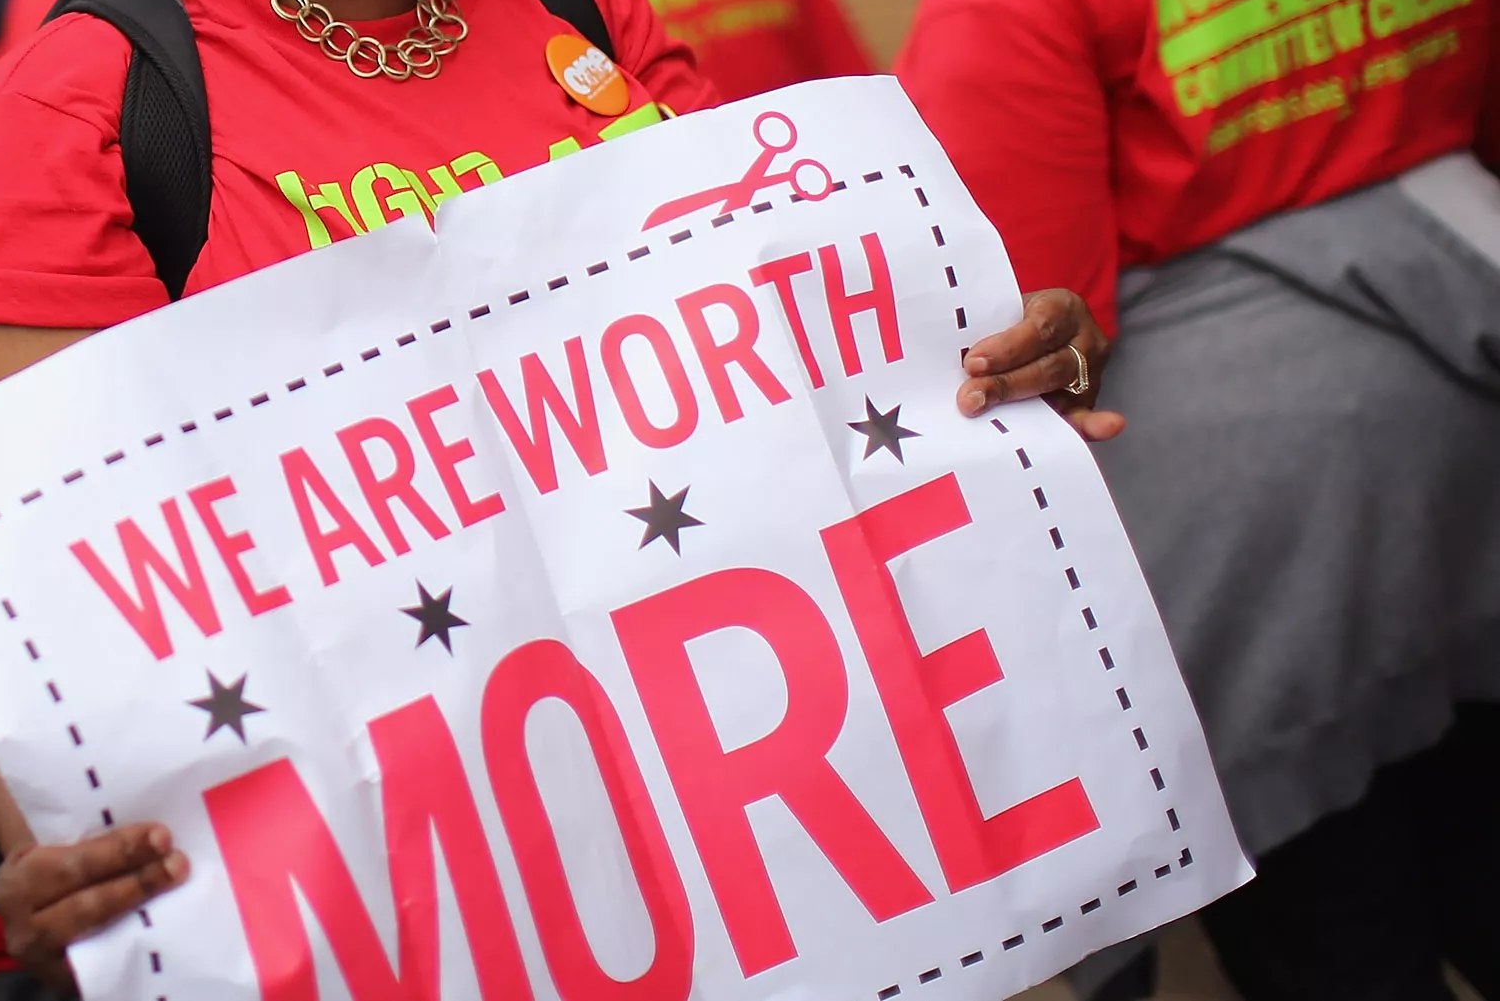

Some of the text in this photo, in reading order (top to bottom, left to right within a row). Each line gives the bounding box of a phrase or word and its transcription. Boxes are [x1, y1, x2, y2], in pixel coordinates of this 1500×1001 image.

[69, 233, 904, 661] WE ARE WORTH
[202, 472, 1100, 1001] MORE
